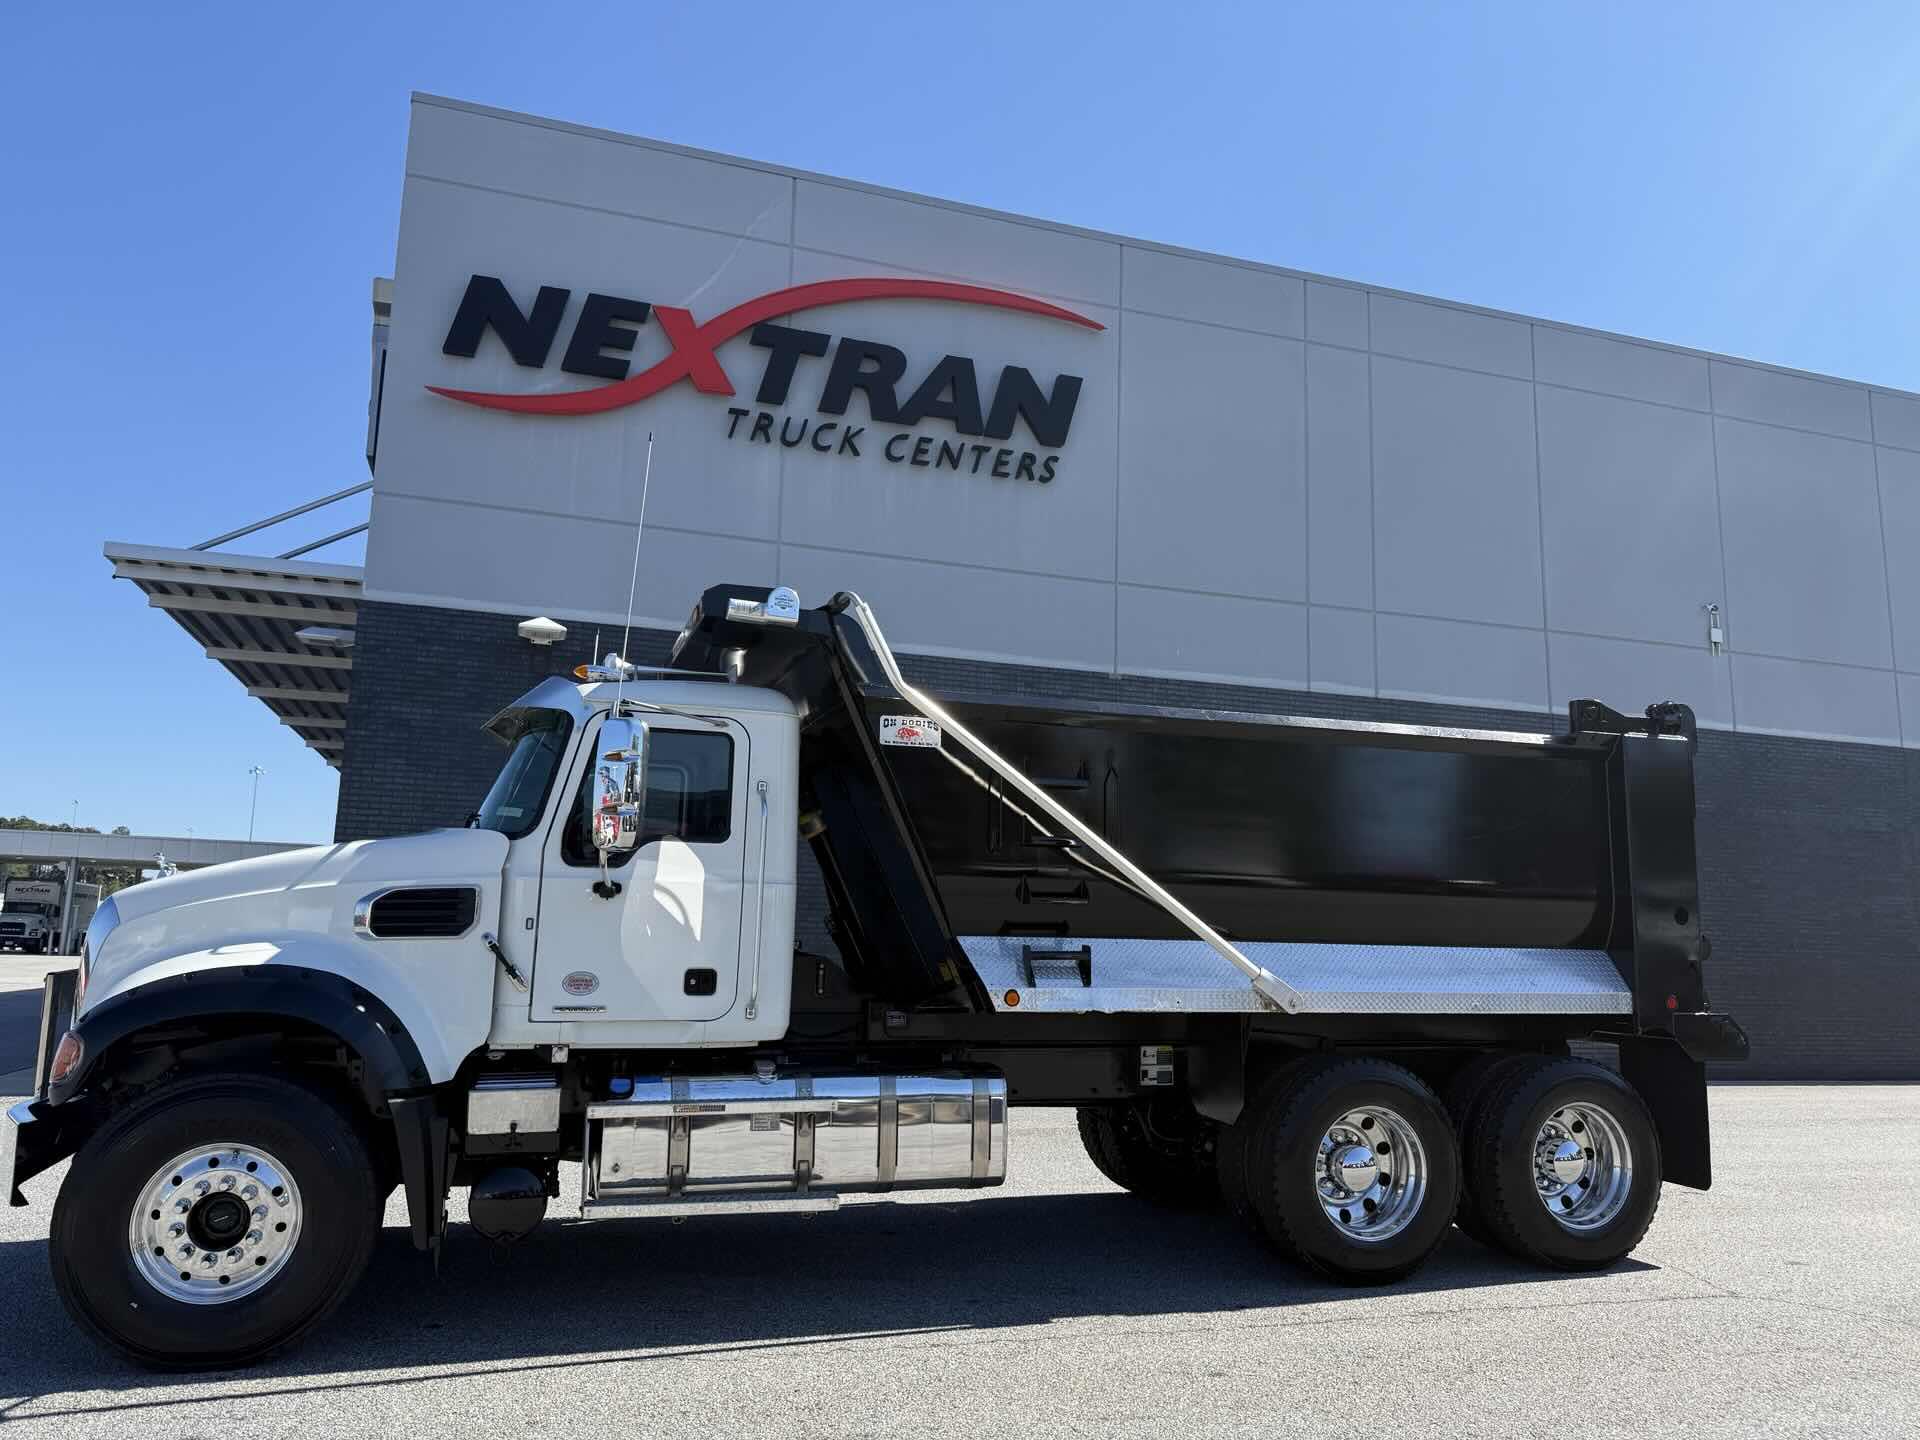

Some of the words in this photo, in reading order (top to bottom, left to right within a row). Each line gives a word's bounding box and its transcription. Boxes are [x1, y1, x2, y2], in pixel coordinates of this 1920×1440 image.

[440, 274, 1086, 449] NEXTRAN
[727, 406, 865, 458] TRUCK
[884, 432, 1060, 485] CENTERS
